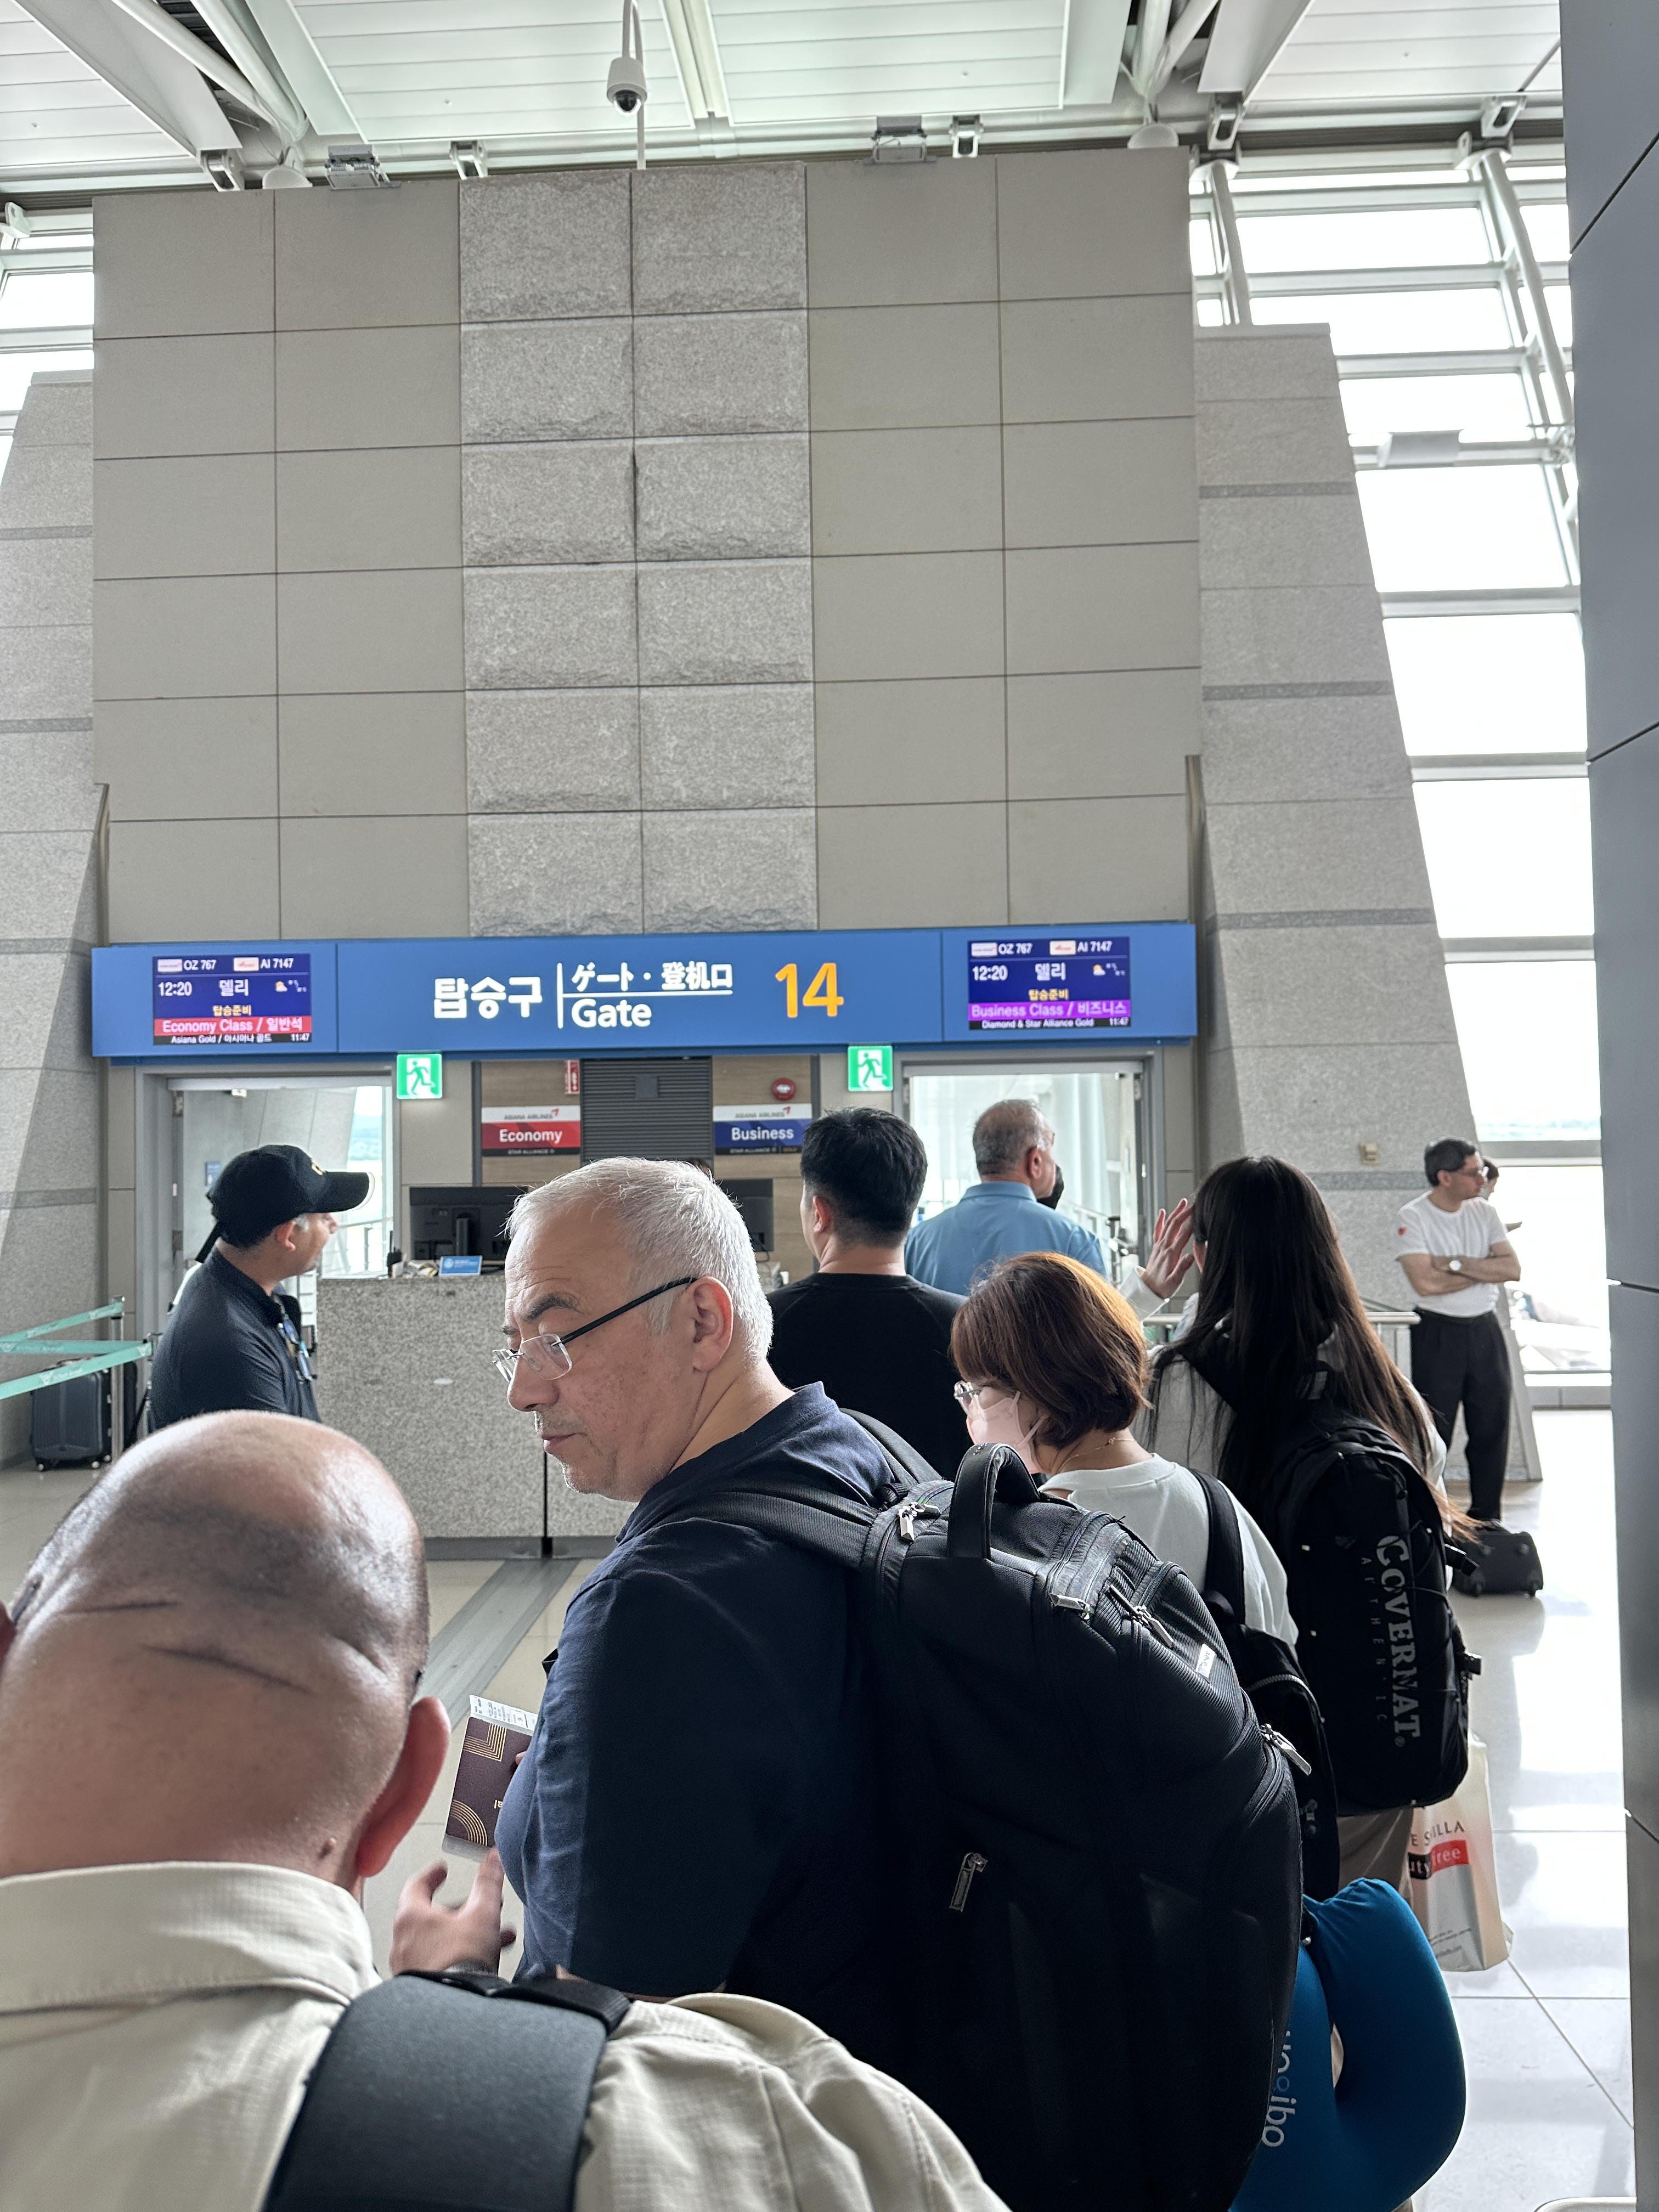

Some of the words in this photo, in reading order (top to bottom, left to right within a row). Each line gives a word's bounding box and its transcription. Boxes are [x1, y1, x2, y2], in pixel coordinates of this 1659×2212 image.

[998, 943, 1014, 955] OZ
[1016, 943, 1032, 954] 767
[1077, 941, 1088, 952] AI
[1090, 940, 1112, 952] 7147
[184, 960, 198, 970] OZ
[201, 959, 216, 970] 767
[261, 958, 270, 969] AI
[273, 958, 294, 969] 7147
[972, 964, 1008, 981] 12:20
[1035, 962, 1066, 981] 델리
[159, 981, 192, 996] 12:20
[219, 979, 249, 996] 델리
[775, 963, 844, 1018] 14
[1029, 988, 1069, 1001] 탑승준비
[434, 976, 543, 1019] 탑승구
[213, 1005, 251, 1017] 탑승준비
[571, 998, 652, 1028] Gate
[972, 1004, 1026, 1018] Business
[1029, 1003, 1063, 1017] Class
[1077, 1001, 1127, 1017] 비즈니스
[163, 1019, 217, 1035] Economy
[220, 1019, 253, 1032] Class
[267, 1017, 302, 1032] 일반석
[982, 1020, 1015, 1029] Diamond
[171, 1035, 196, 1044] Asiana
[224, 1034, 254, 1043] 아시아나
[291, 1032, 310, 1042] 11:47
[499, 1128, 562, 1144] Economy
[731, 1126, 794, 1141] Business
[1376, 1535, 1421, 1737] COVERNAT
[1431, 1847, 1462, 1869] free
